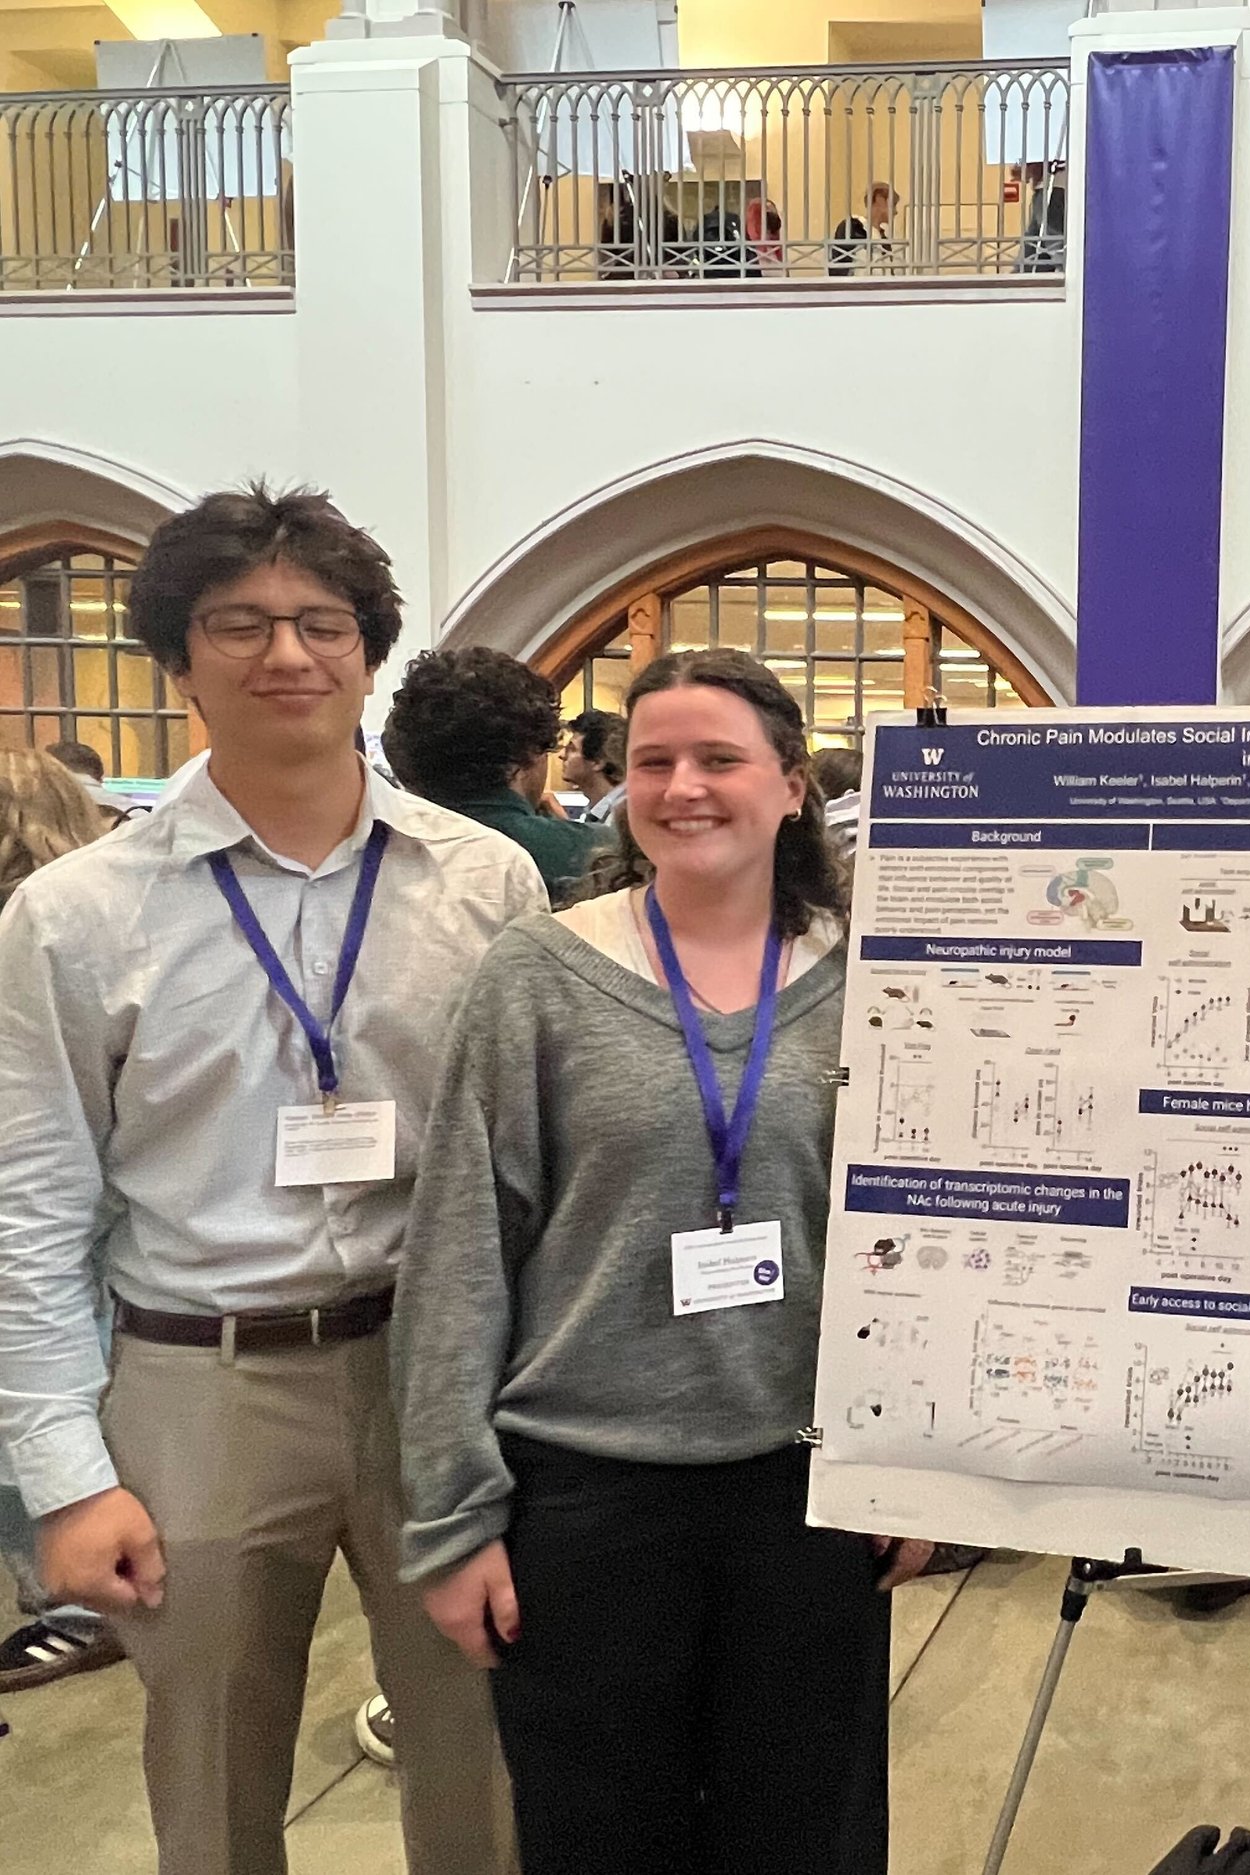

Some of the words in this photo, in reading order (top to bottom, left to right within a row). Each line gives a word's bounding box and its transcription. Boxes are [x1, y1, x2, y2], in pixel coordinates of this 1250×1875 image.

[977, 730, 1041, 746] Chronic
[1046, 729, 1083, 745] Pain
[1089, 728, 1177, 744] Modulates
[1182, 727, 1236, 744] Social
[921, 748, 945, 765] W
[892, 771, 961, 783] UNIVERSITY
[963, 772, 975, 784] of
[1053, 774, 1097, 787] William
[1151, 774, 1187, 787] Isabel
[883, 785, 979, 799] WASHINGTON
[971, 830, 1042, 845] Background
[926, 943, 997, 958] Neuropathic
[999, 945, 1031, 960] injury
[1034, 946, 1072, 958] model
[1162, 1096, 1209, 1111] Female
[1212, 1098, 1243, 1112] mice
[851, 1174, 927, 1190] Identification
[930, 1177, 943, 1190] of
[945, 1179, 1031, 1196] transcriptomic
[1034, 1184, 1085, 1200] changes
[1089, 1186, 1100, 1199] in
[1103, 1187, 1123, 1200] the
[907, 1194, 931, 1207] NAc
[935, 1194, 989, 1213] following
[992, 1199, 1026, 1213] acute
[1028, 1201, 1062, 1216] injury
[1132, 1293, 1159, 1309] Early
[1161, 1296, 1201, 1309] access
[1203, 1299, 1216, 1310] to
